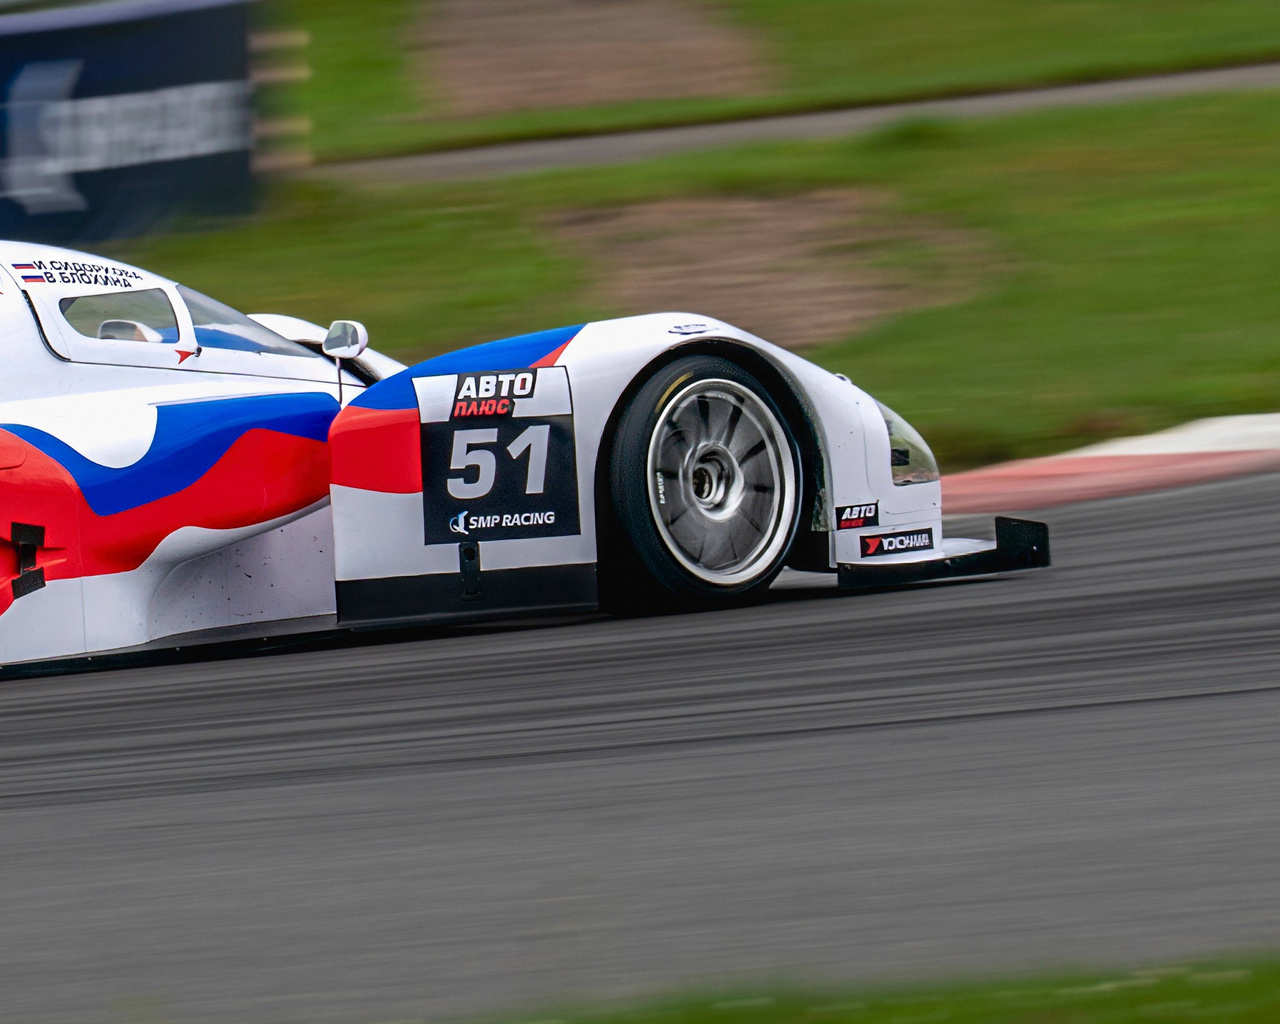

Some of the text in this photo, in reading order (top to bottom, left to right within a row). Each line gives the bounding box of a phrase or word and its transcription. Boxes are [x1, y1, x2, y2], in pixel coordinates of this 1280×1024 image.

[457, 373, 533, 399] АВТО
[453, 398, 510, 418] ПЛЮС
[446, 424, 551, 499] 51
[468, 512, 555, 529] SMP RACING
